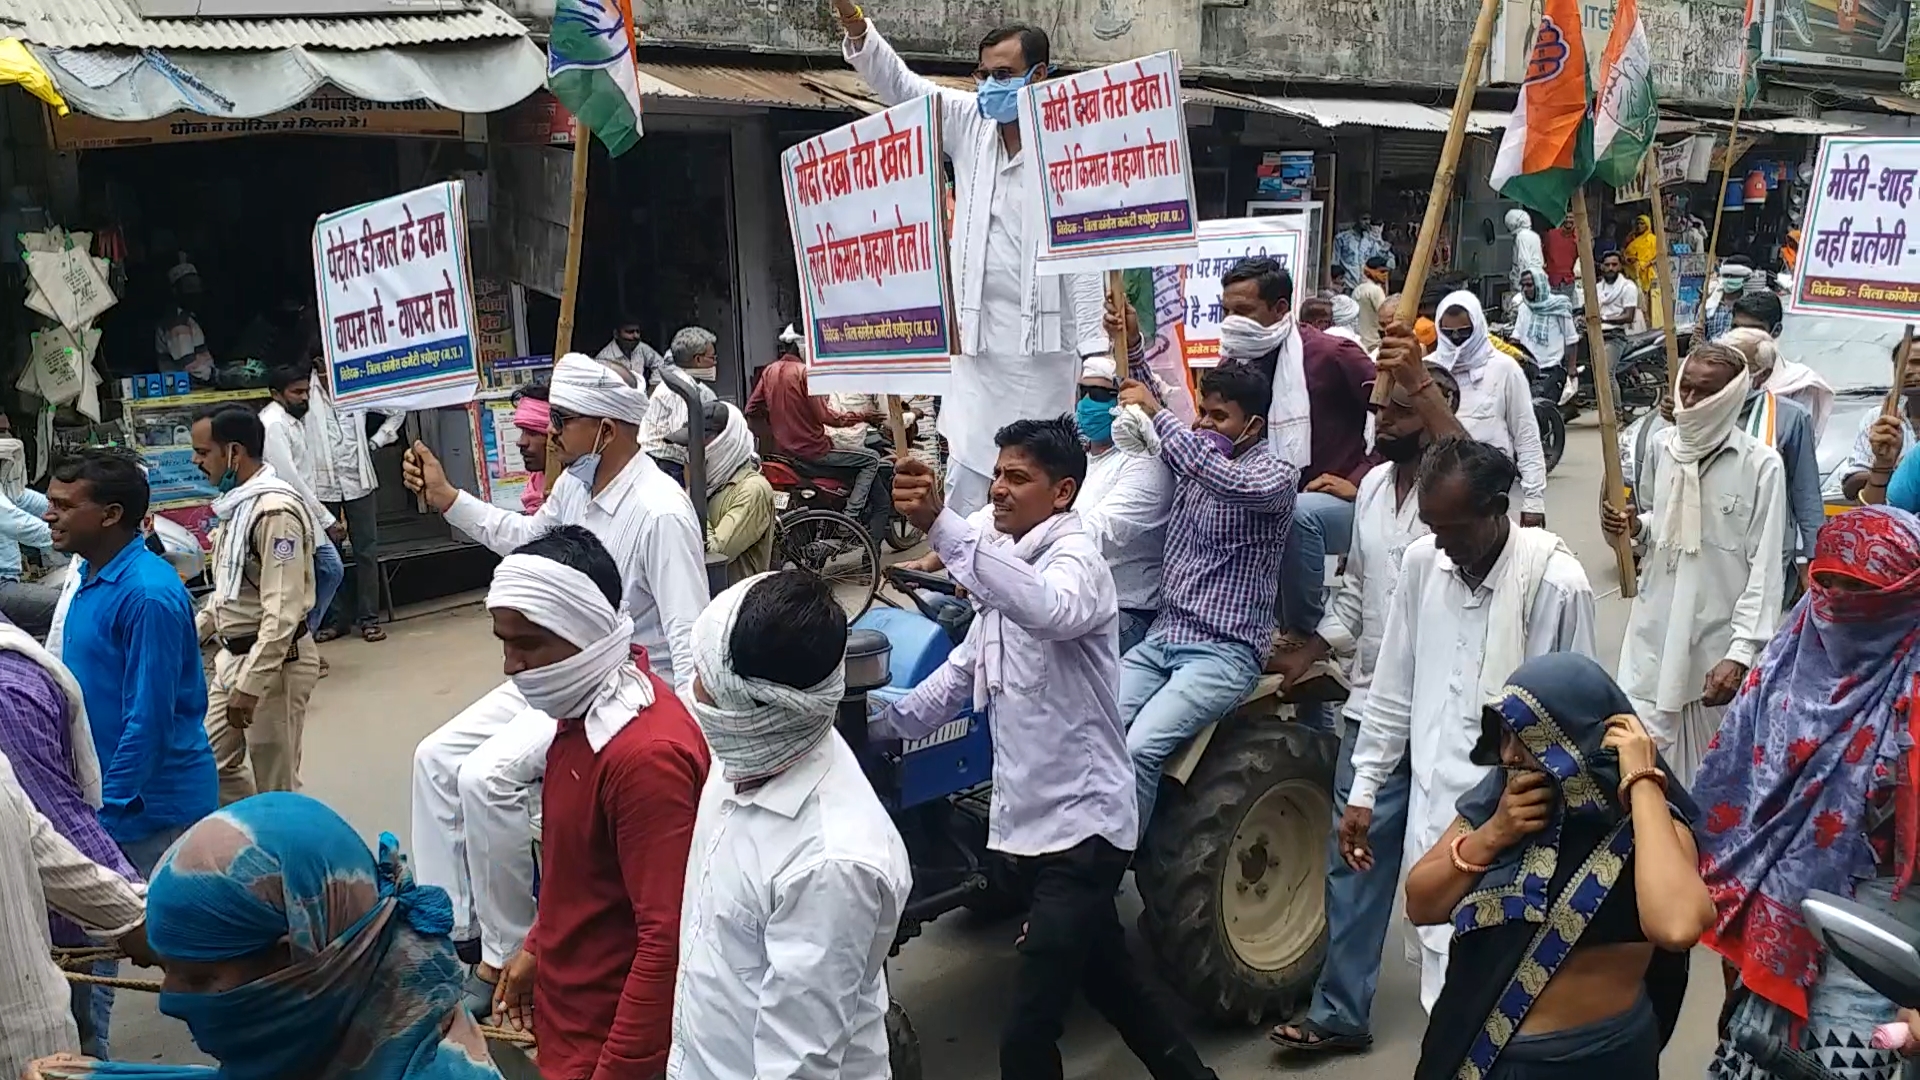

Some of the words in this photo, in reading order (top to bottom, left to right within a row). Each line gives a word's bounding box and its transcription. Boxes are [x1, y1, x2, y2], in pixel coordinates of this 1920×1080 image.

[1582, 4, 1608, 31] ITE
[1041, 84, 1071, 132] मोदी
[1071, 79, 1100, 127] देखा
[1102, 70, 1127, 119] तेरा
[795, 141, 822, 207] मोदी
[820, 137, 852, 201] देखा
[850, 124, 877, 191] तेरा
[1074, 143, 1109, 190] किसान
[327, 226, 360, 292] पेट्रोल
[360, 218, 400, 274] डीजल
[400, 203, 415, 262] के
[417, 212, 447, 258] दाम
[826, 222, 863, 284] किसान
[1814, 216, 1853, 268] नहीं
[1850, 216, 1906, 267] चलेगी
[334, 310, 369, 353] वापस
[368, 287, 387, 344] लो
[396, 293, 435, 338] वापस
[435, 269, 458, 329] लो
[1858, 282, 1883, 302] जिला
